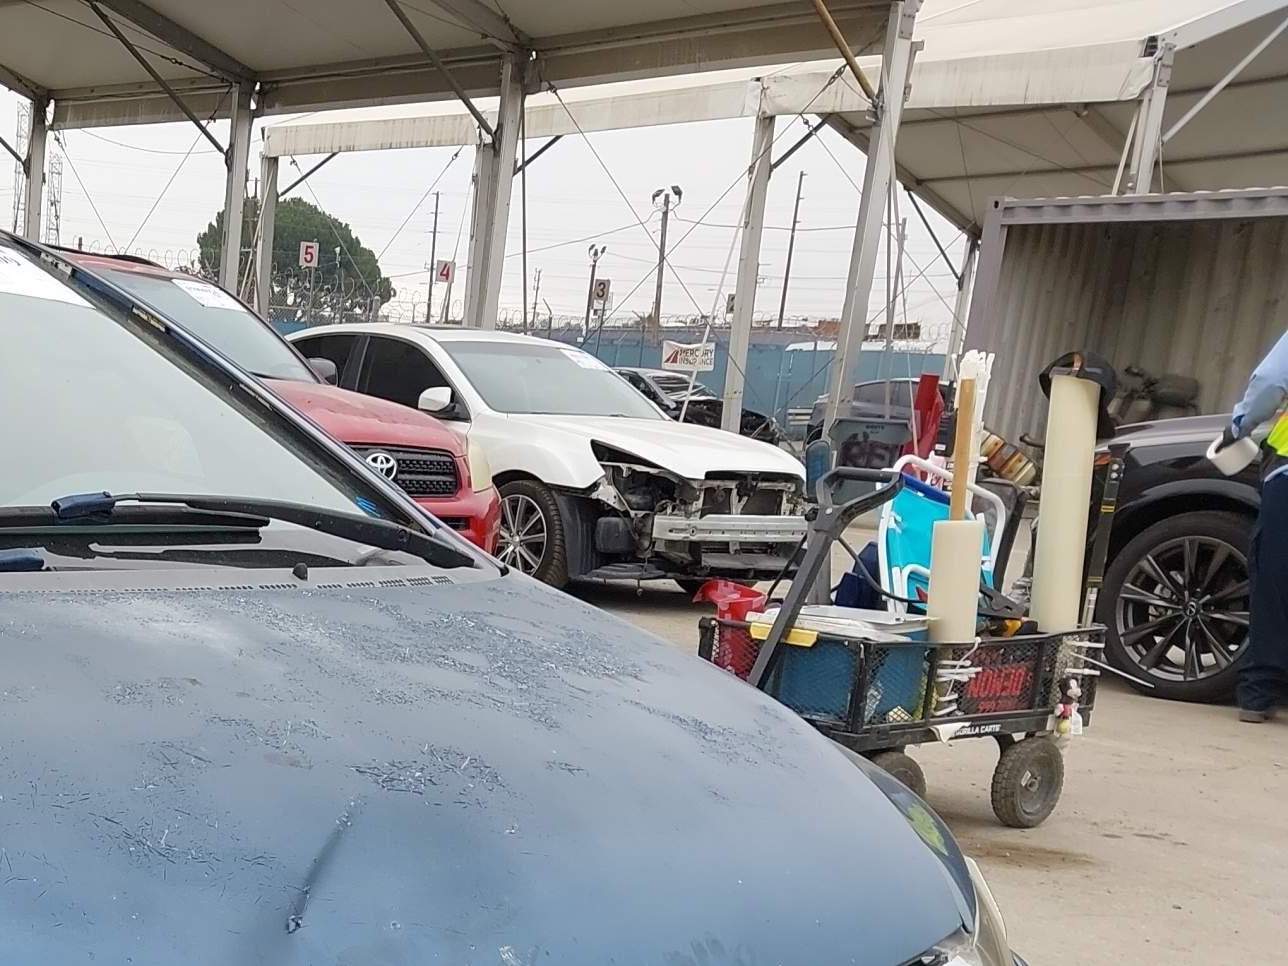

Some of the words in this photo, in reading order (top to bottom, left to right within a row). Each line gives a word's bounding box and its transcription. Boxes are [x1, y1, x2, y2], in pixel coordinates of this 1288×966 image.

[304, 245, 314, 264] 5
[439, 262, 450, 281] 4
[596, 281, 607, 298] 3
[679, 357, 713, 366] INSURNCE
